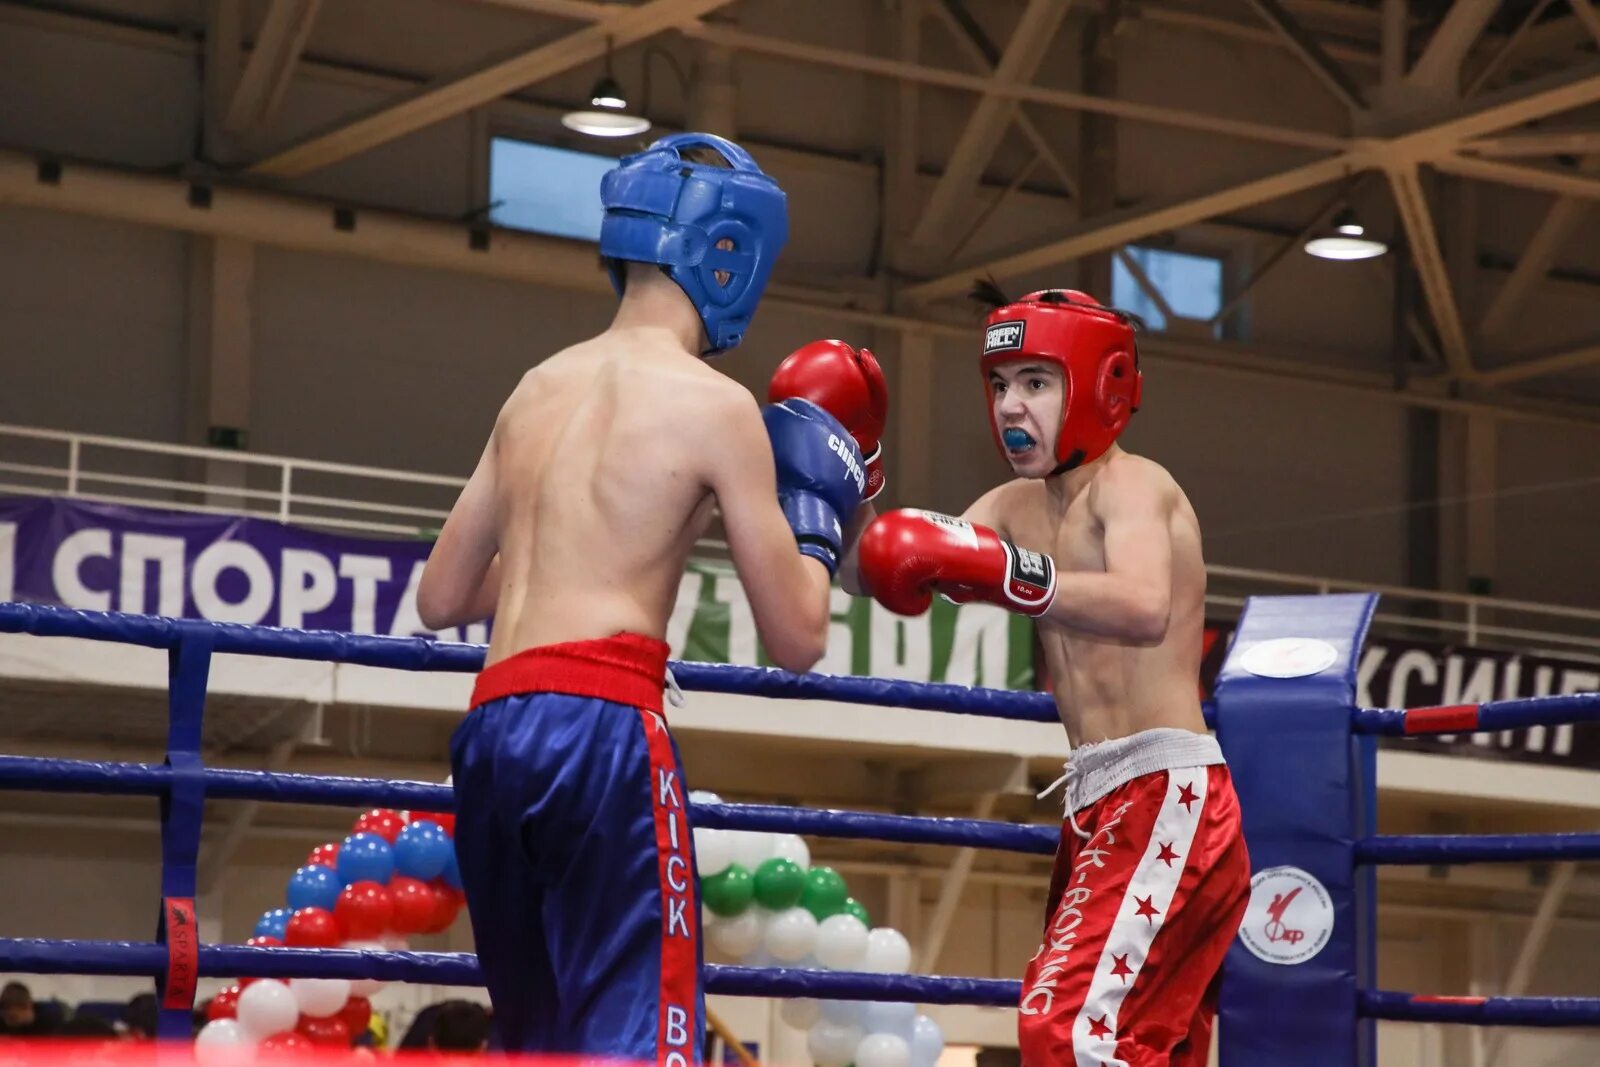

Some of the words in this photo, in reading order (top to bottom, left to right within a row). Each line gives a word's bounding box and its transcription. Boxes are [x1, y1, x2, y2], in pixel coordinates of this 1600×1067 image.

[987, 334, 1013, 349] HILL
[988, 326, 1020, 340] GREEN
[658, 768, 690, 938] KICK
[172, 930, 189, 997] SPARTA
